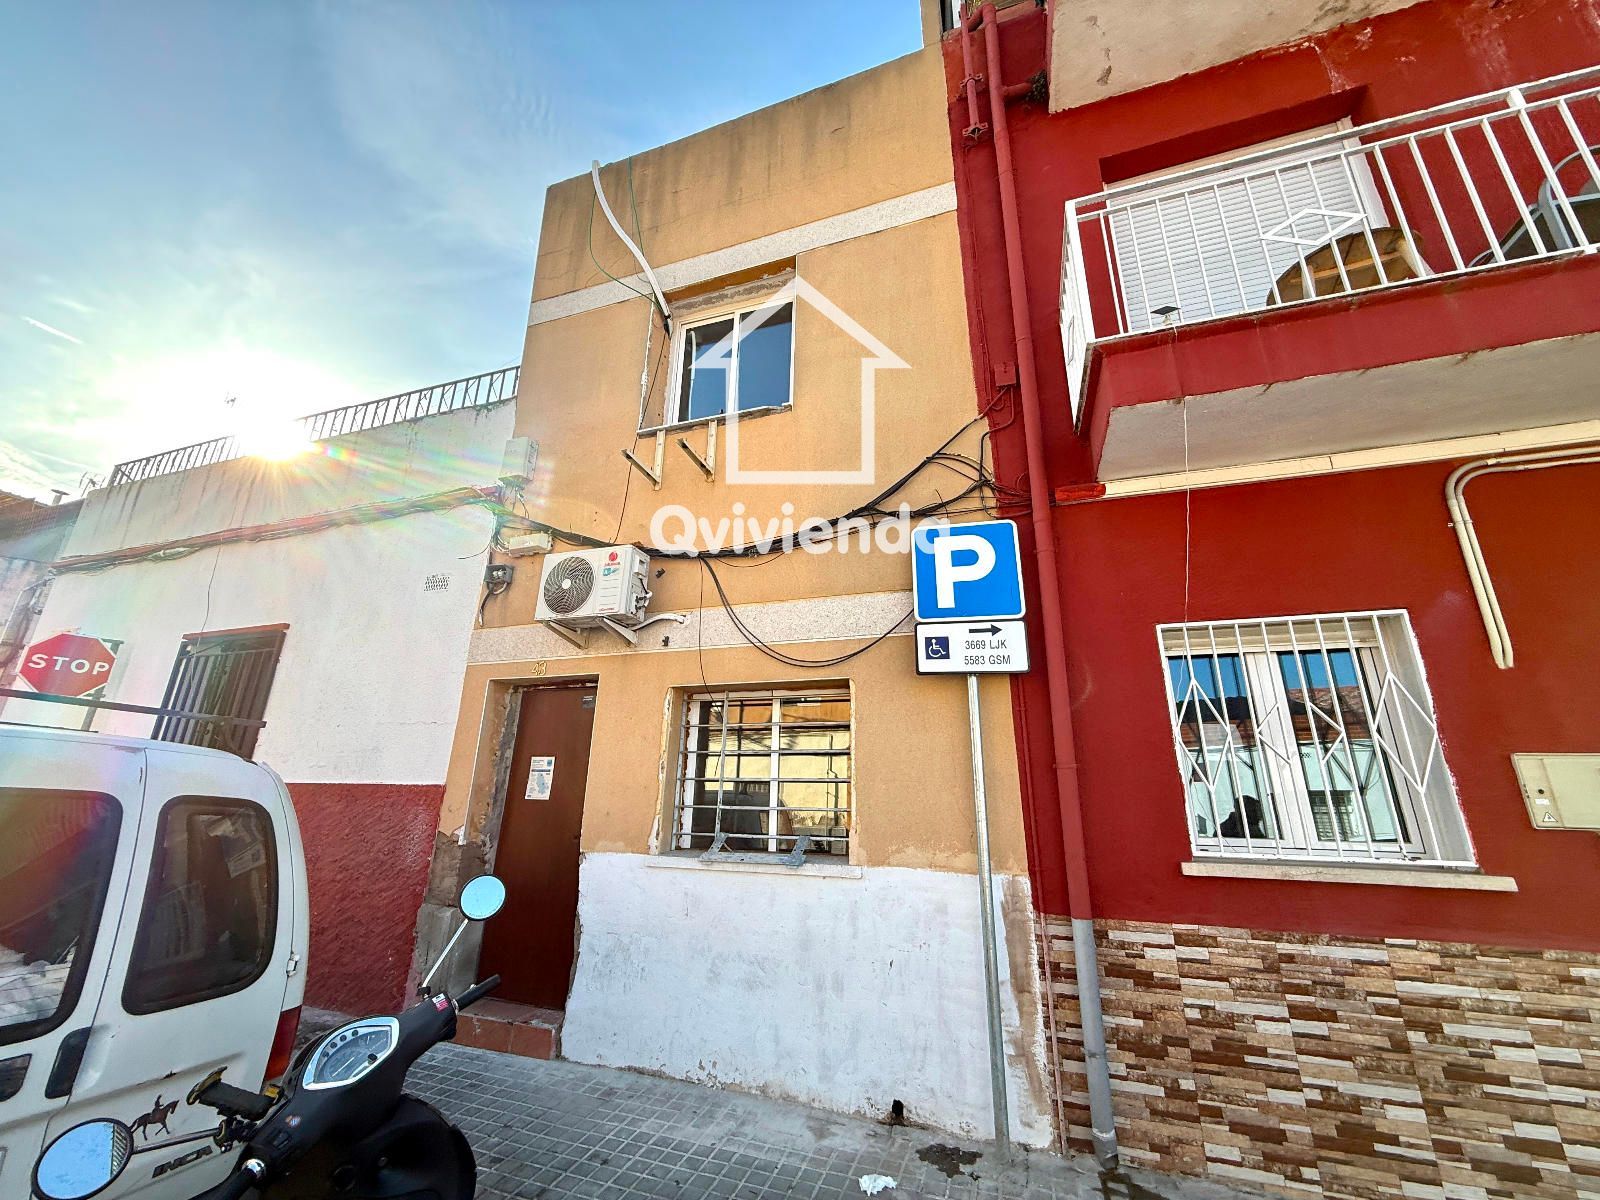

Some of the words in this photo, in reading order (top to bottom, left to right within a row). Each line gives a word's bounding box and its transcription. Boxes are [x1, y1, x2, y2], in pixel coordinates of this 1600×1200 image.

[934, 534, 996, 609] P
[964, 640, 986, 650] 3669
[989, 639, 1008, 649] LJK
[27, 653, 110, 675] STOP
[964, 655, 986, 665] 5583
[988, 654, 1011, 665] GSM
[531, 660, 547, 676] 43
